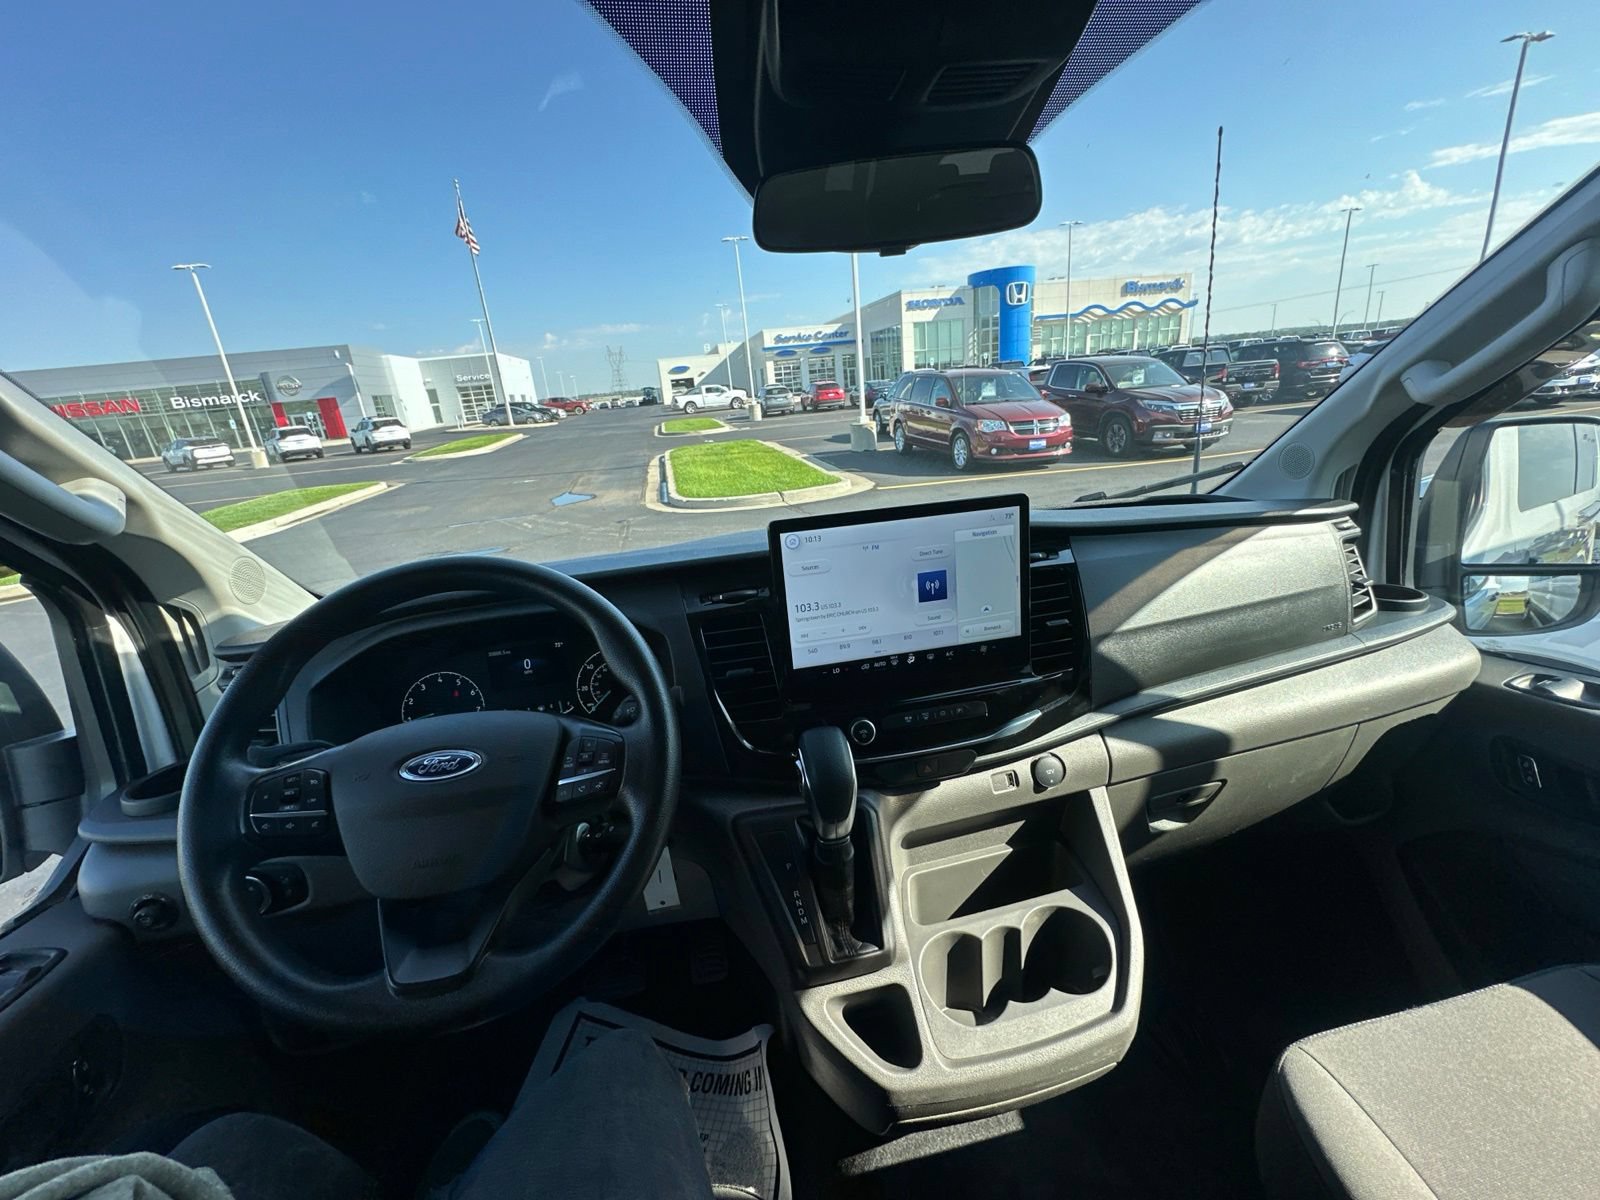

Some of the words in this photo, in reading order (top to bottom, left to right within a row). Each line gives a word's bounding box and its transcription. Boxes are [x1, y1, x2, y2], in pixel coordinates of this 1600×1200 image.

[1122, 276, 1185, 294] Bismarck
[907, 296, 964, 309] HONDA
[774, 333, 812, 343] Service
[814, 330, 849, 340] Center
[456, 373, 490, 382] Service
[169, 390, 261, 409] Bismarck
[972, 529, 998, 538] Navigation
[795, 602, 820, 614] 103.3
[523, 658, 531, 670] 0
[420, 683, 426, 691] 3
[455, 678, 461, 686] 5
[408, 697, 414, 705] 2
[417, 755, 461, 775] Ford
[793, 890, 800, 898] R
[795, 899, 802, 907] N
[800, 916, 808, 925] M
[691, 1070, 752, 1097] COMING
